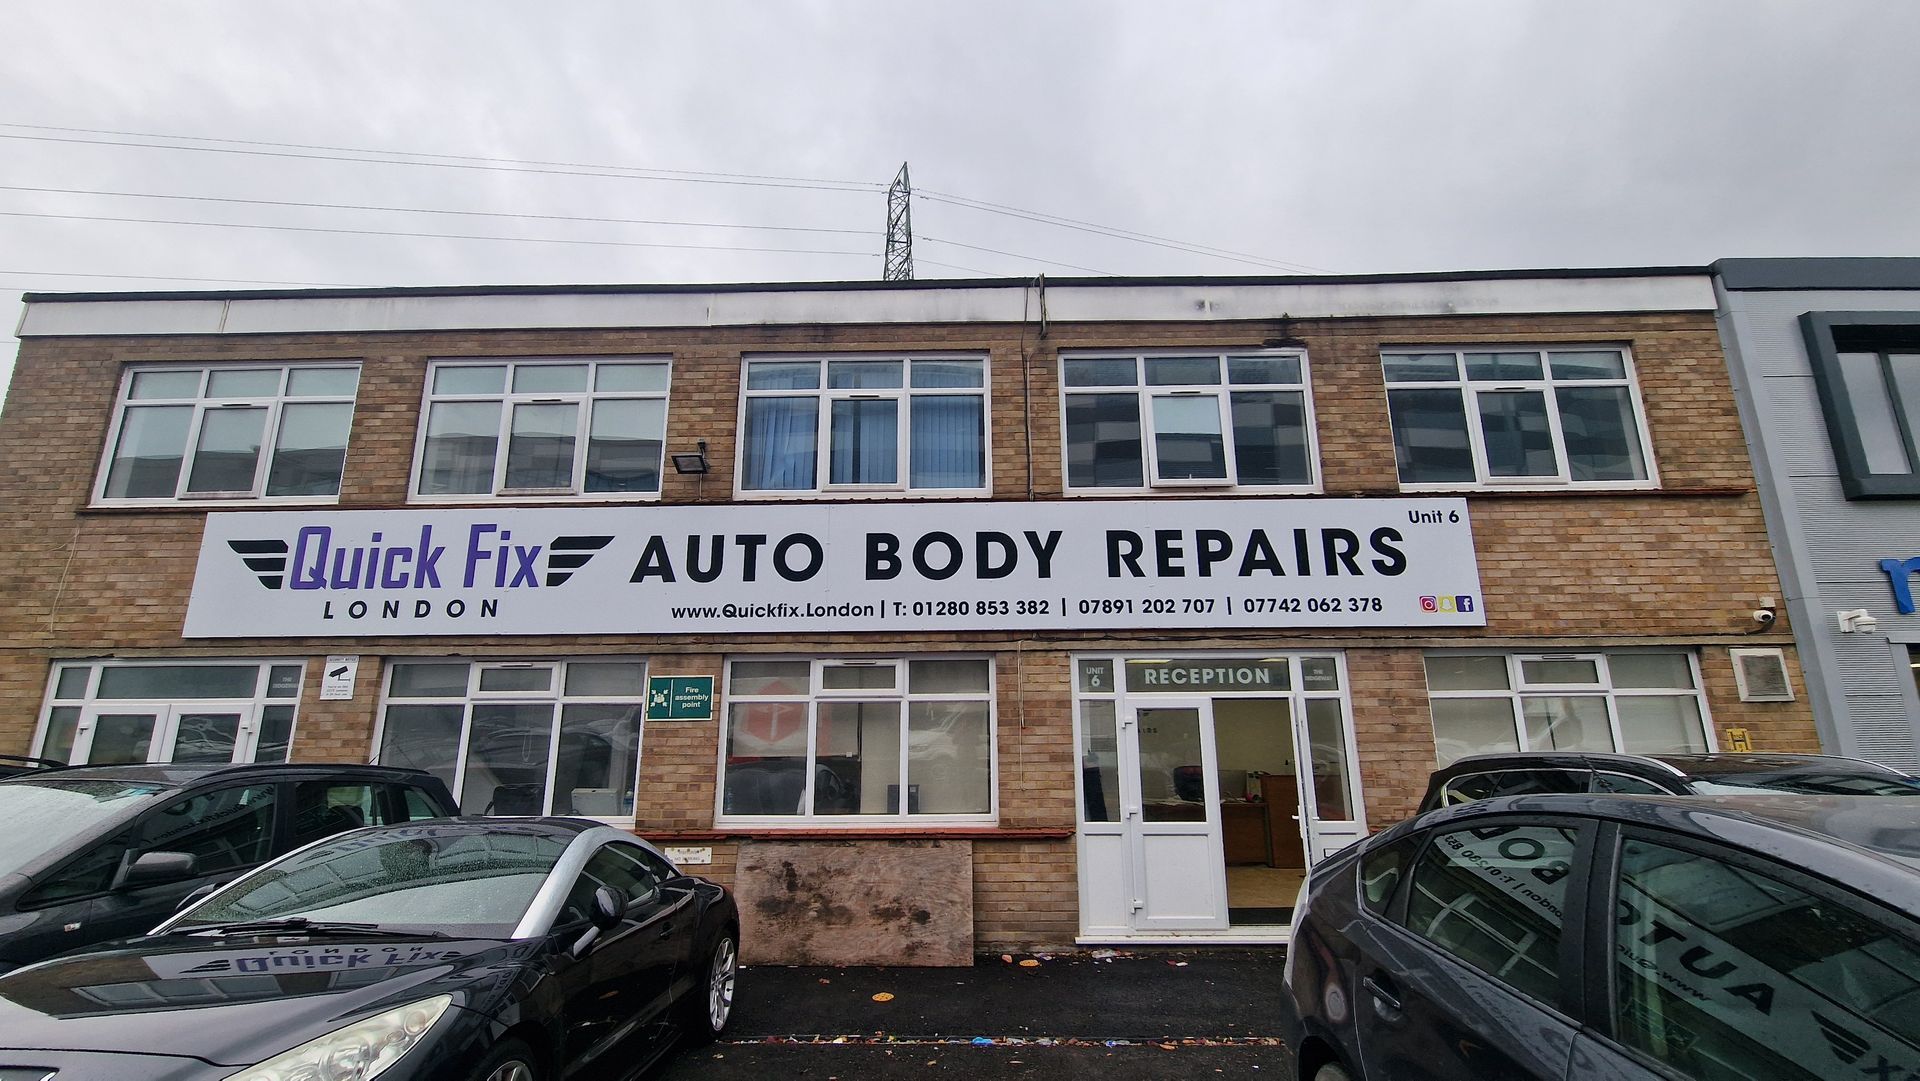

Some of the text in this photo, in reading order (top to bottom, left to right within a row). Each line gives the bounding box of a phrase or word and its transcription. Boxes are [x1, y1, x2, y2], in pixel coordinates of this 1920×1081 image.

[1408, 510, 1460, 523] Unit 6
[290, 524, 541, 590] Quick Fix
[629, 527, 1407, 583] AUTO BODY REPAIRS
[323, 599, 498, 619] LONDON
[671, 602, 874, 619] www.Quickfix.London
[893, 602, 906, 616] T:
[912, 600, 970, 616] 01280
[976, 600, 1009, 615] 853
[1016, 600, 1050, 615] 382
[1079, 599, 1133, 614] 07891
[1142, 599, 1175, 614] 202
[1183, 598, 1215, 614] 707
[1244, 598, 1301, 613] 07742
[1308, 598, 1342, 612] 062
[1349, 598, 1383, 612] 378
[1086, 667, 1104, 675] UNIT
[1145, 668, 1270, 685] RECEPTION
[1091, 675, 1101, 687] 6
